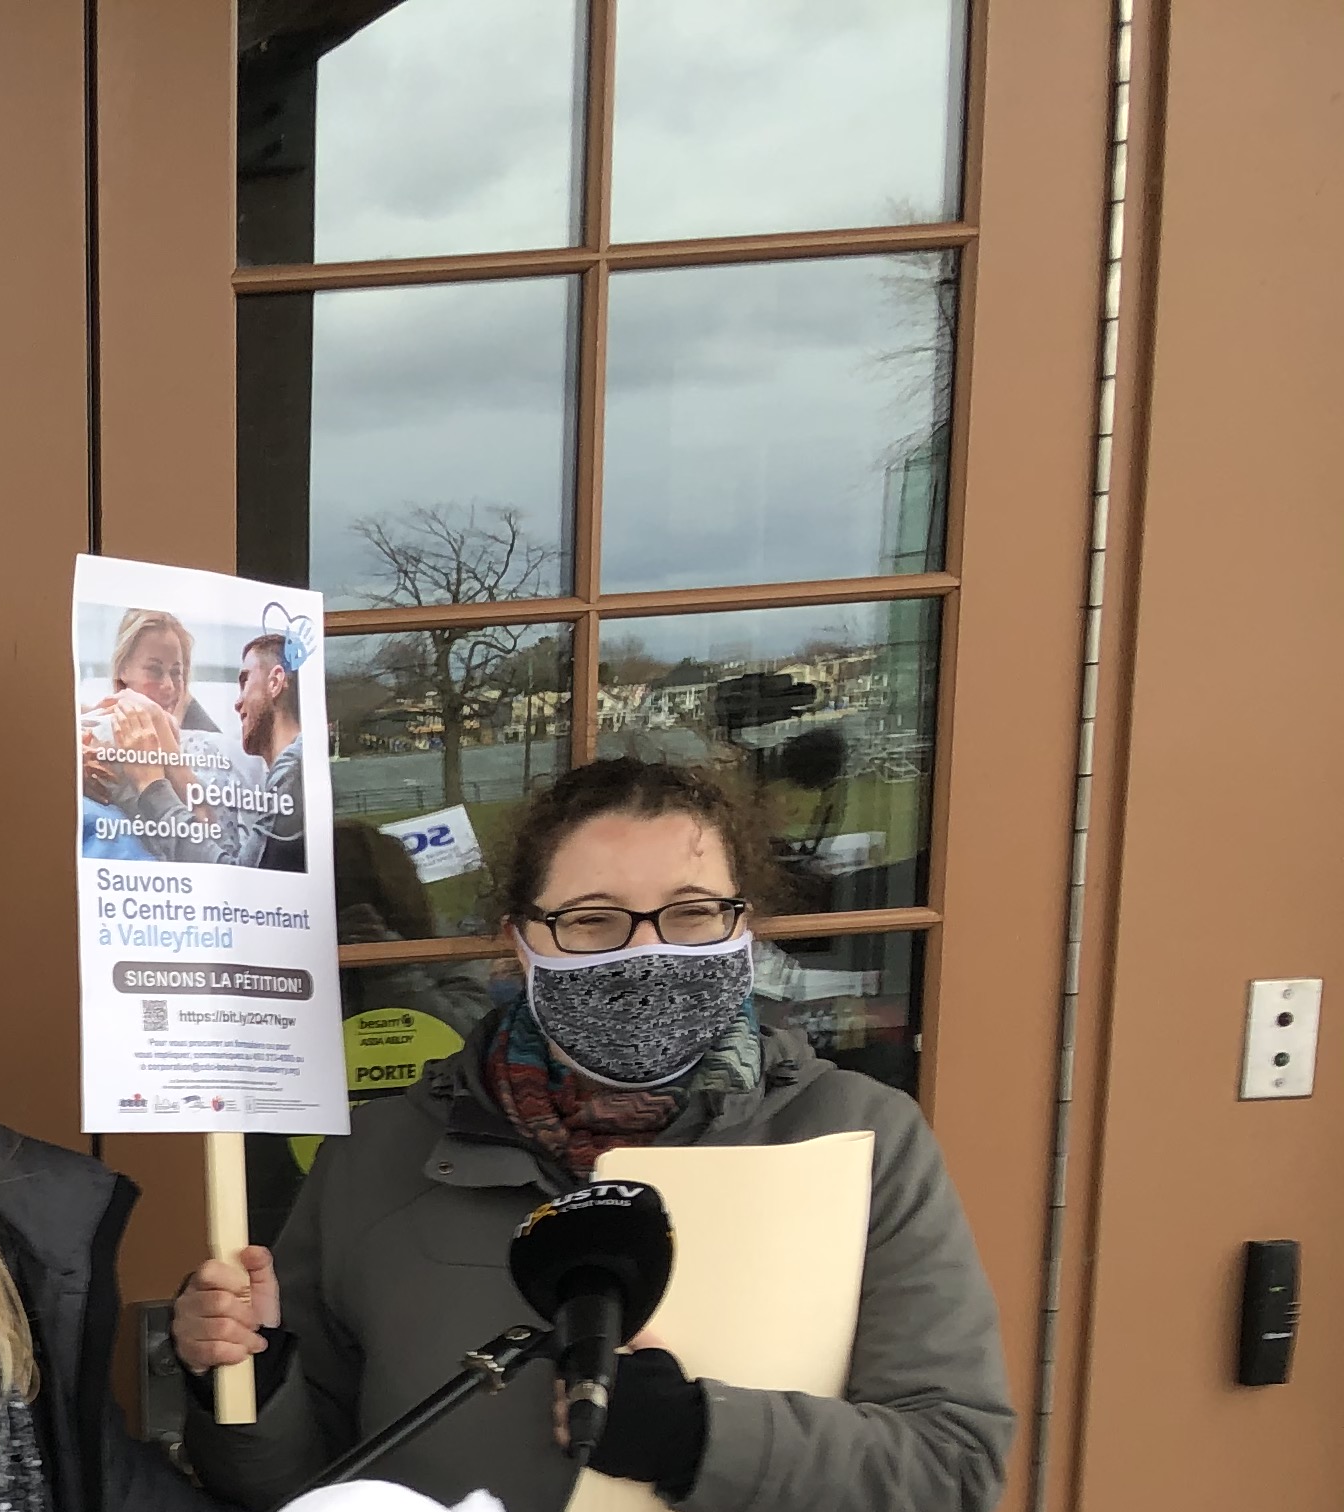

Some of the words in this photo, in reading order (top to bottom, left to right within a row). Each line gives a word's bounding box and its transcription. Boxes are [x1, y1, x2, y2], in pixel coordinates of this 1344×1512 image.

[96, 747, 231, 770] accouchements
[186, 779, 294, 816] pédiatrie
[95, 814, 222, 844] gynécologie
[97, 867, 193, 894] Sauvons
[98, 897, 116, 918] le
[122, 897, 196, 921] Centre
[203, 901, 311, 930] mère-enfant
[99, 923, 112, 946] à
[118, 924, 233, 953] Valleyfield
[124, 970, 206, 988] SIGNONS
[211, 973, 231, 988] LA
[235, 971, 303, 993] PÉTITION!
[355, 1063, 416, 1083] PORTE
